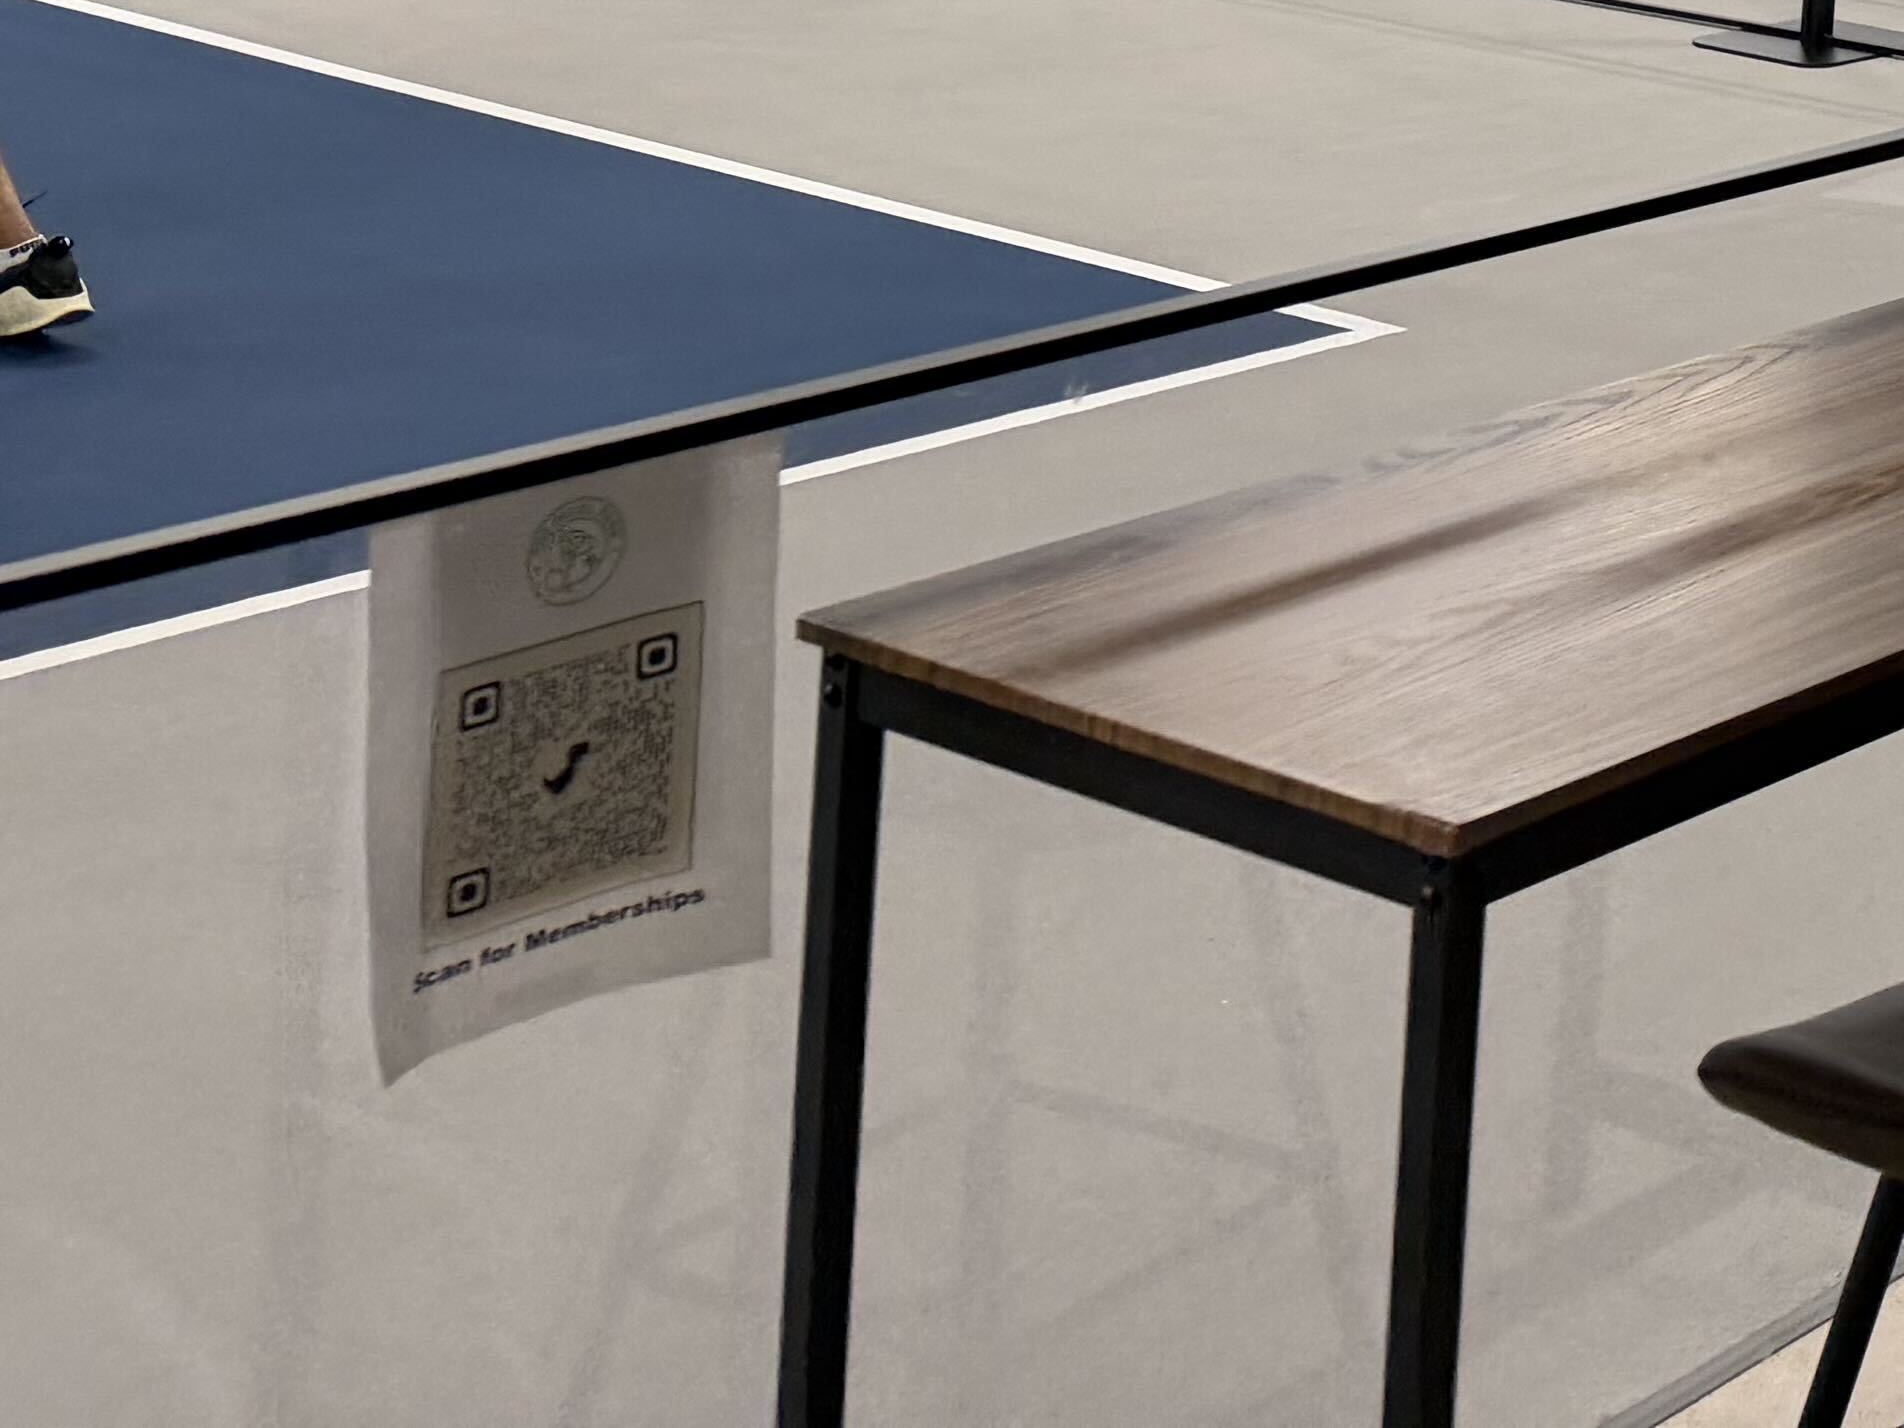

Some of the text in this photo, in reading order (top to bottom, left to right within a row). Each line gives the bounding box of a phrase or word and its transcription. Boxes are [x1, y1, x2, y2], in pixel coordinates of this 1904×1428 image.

[413, 889, 705, 993] Scan for Memberships
